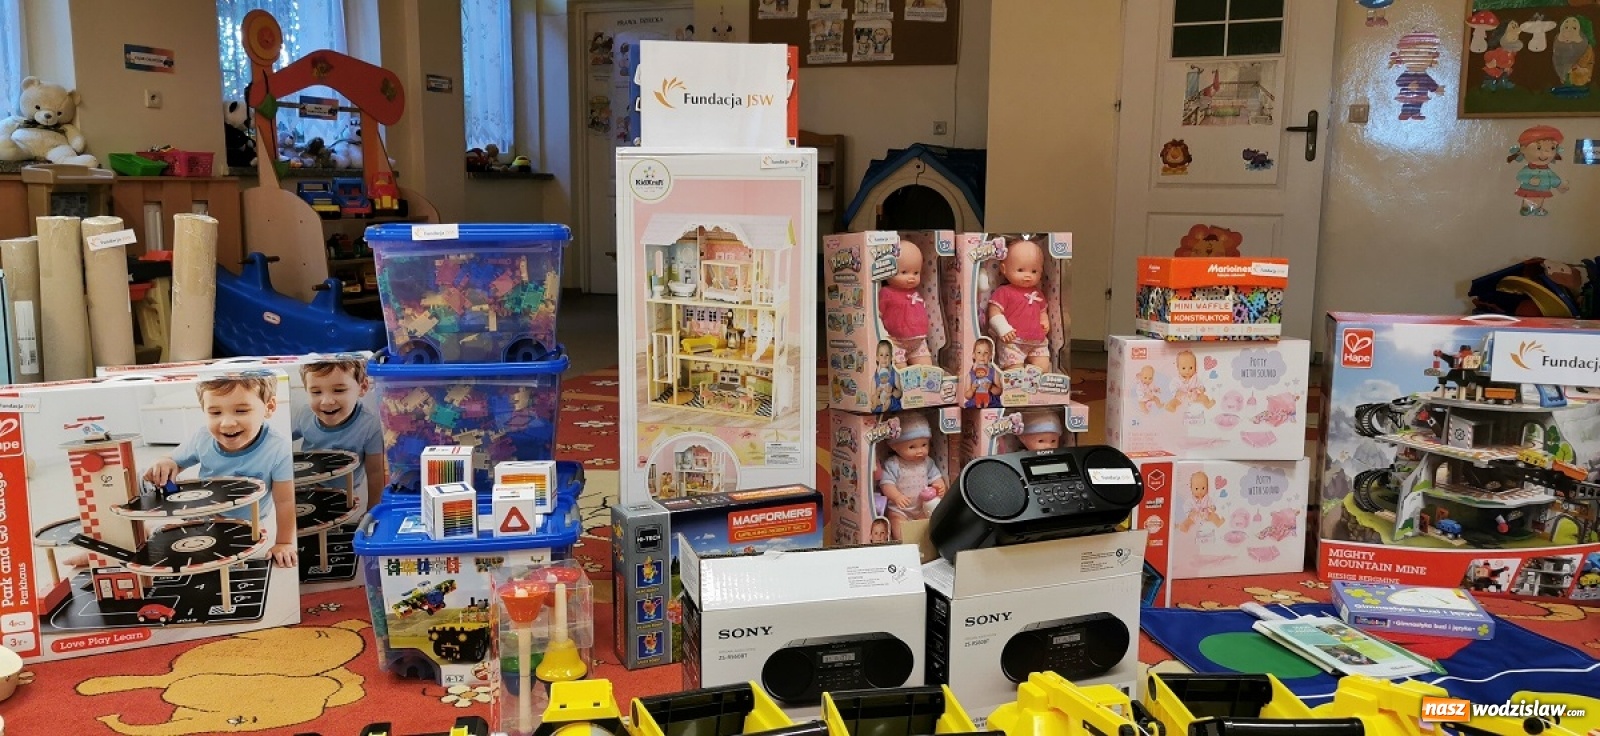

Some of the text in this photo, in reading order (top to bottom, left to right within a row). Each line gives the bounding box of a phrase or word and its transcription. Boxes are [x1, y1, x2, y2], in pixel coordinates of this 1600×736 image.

[683, 93, 774, 109] Fundacja JSW
[1250, 356, 1267, 367] POTTY
[1343, 352, 1370, 364] Hape
[1542, 355, 1600, 373] Fundacj
[1240, 368, 1256, 378] WITH
[0, 441, 20, 453] pe
[732, 508, 813, 526] MAGFORMERS
[0, 524, 9, 546] Go
[0, 547, 11, 575] and
[1328, 548, 1376, 561] MIGHTY
[1328, 558, 1427, 575] MOUNTAIN MINE
[19, 562, 30, 606] Parkhaus
[1327, 572, 1400, 585] RIESIGE BERGMINE
[1, 576, 14, 607] Park
[965, 612, 1012, 627] SONY
[60, 632, 144, 650] Love Play Learn
[718, 626, 773, 640] SONY
